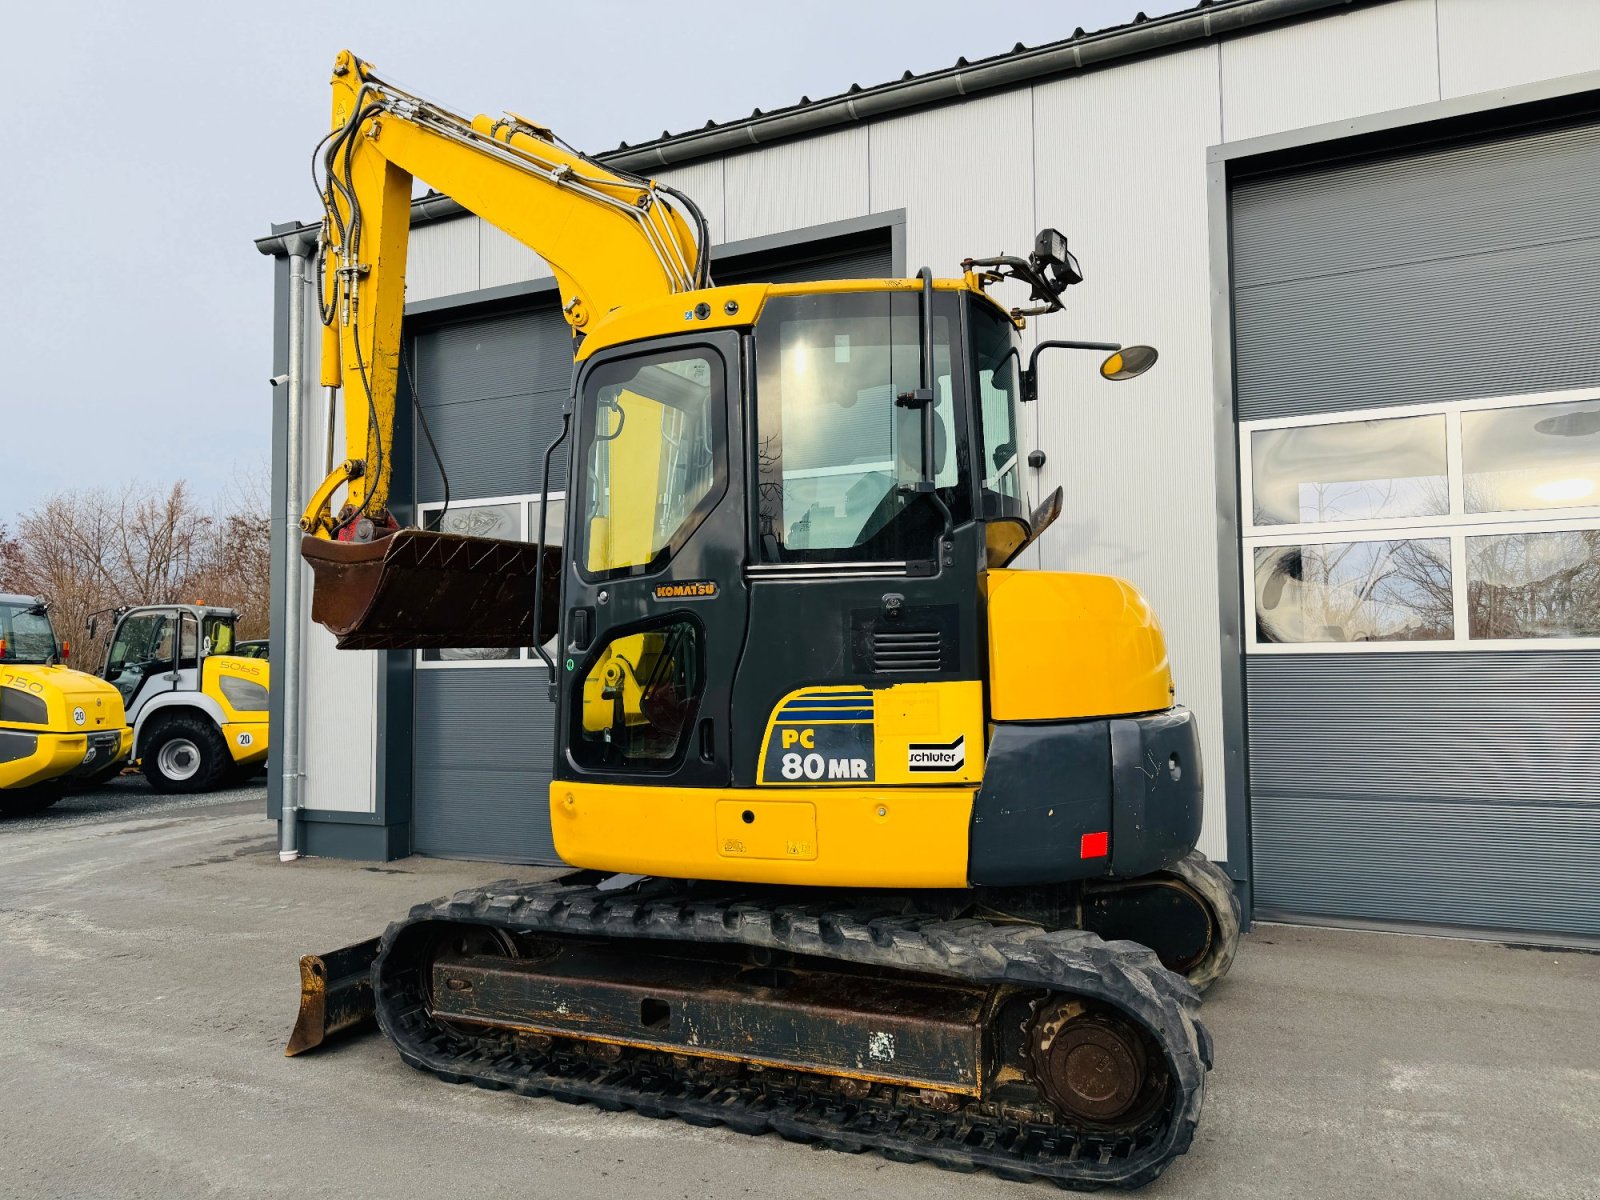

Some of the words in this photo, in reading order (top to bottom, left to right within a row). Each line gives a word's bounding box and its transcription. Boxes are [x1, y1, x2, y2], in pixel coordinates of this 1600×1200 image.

[657, 585, 714, 597] KOMATSU
[4, 674, 43, 693] 750
[74, 711, 84, 721] 20
[240, 734, 250, 745] 20
[781, 729, 815, 748] PC
[781, 753, 825, 780] 80
[828, 758, 868, 778] MR
